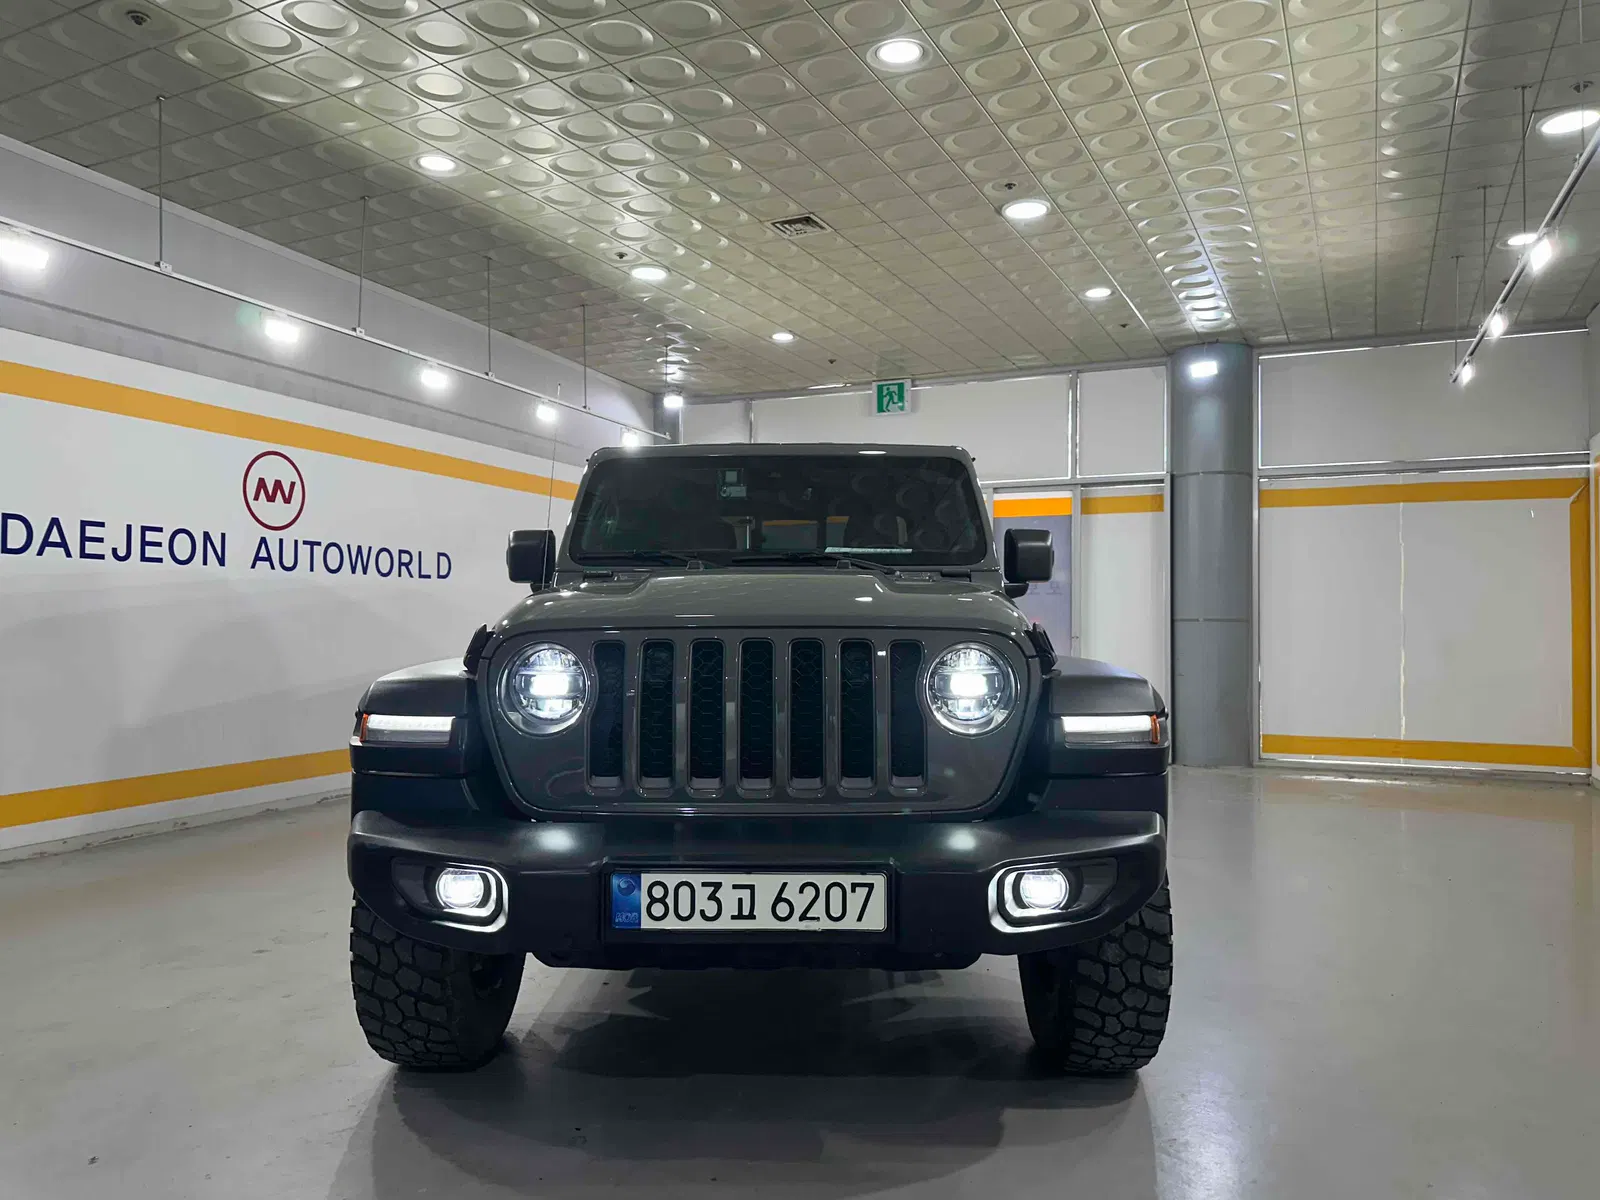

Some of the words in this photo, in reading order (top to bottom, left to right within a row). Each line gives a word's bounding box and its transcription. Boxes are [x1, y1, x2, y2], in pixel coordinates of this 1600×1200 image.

[0, 512, 226, 567] DAEJEON
[251, 536, 452, 580] AUTOWORLD
[645, 880, 757, 922] 803고
[771, 881, 875, 923] 6207
